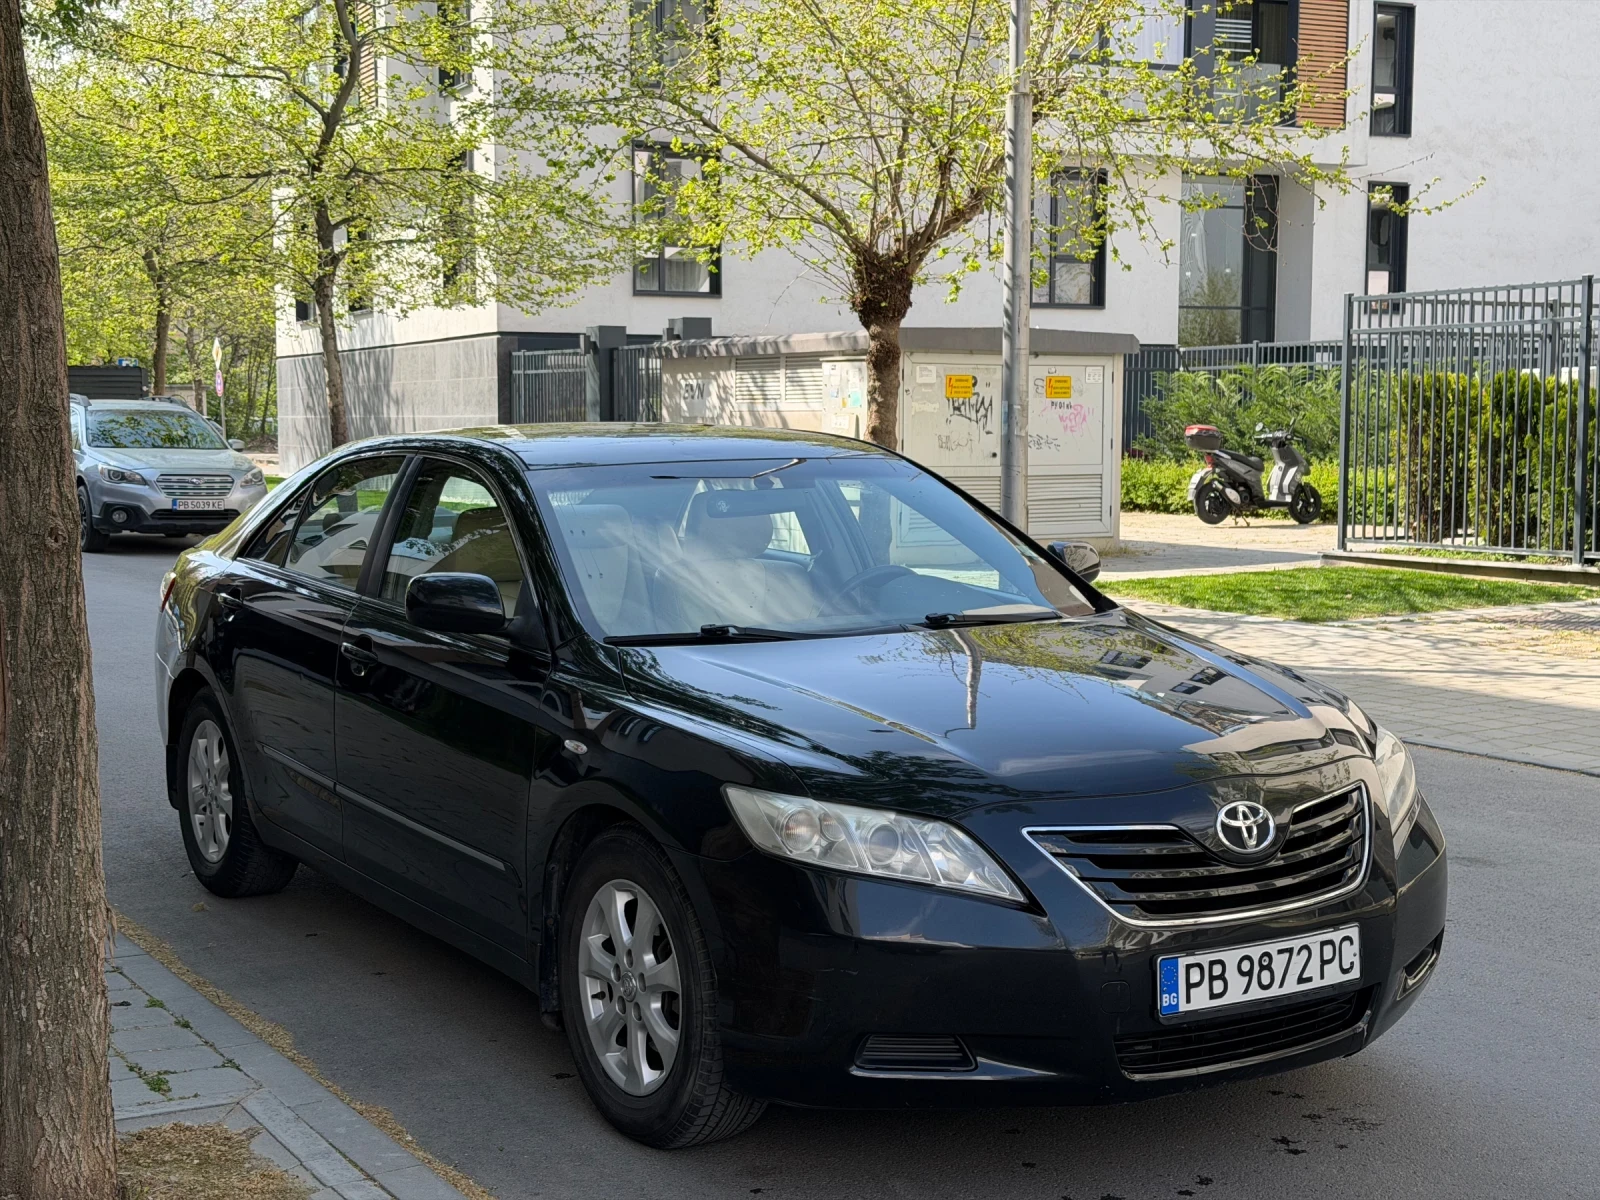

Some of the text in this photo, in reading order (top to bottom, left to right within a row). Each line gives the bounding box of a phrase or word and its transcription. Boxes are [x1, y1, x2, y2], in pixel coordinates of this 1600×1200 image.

[178, 501, 223, 509] PB 5039 KE
[1184, 935, 1355, 1005] PB 9872 PC
[1161, 993, 1178, 1007] BG
